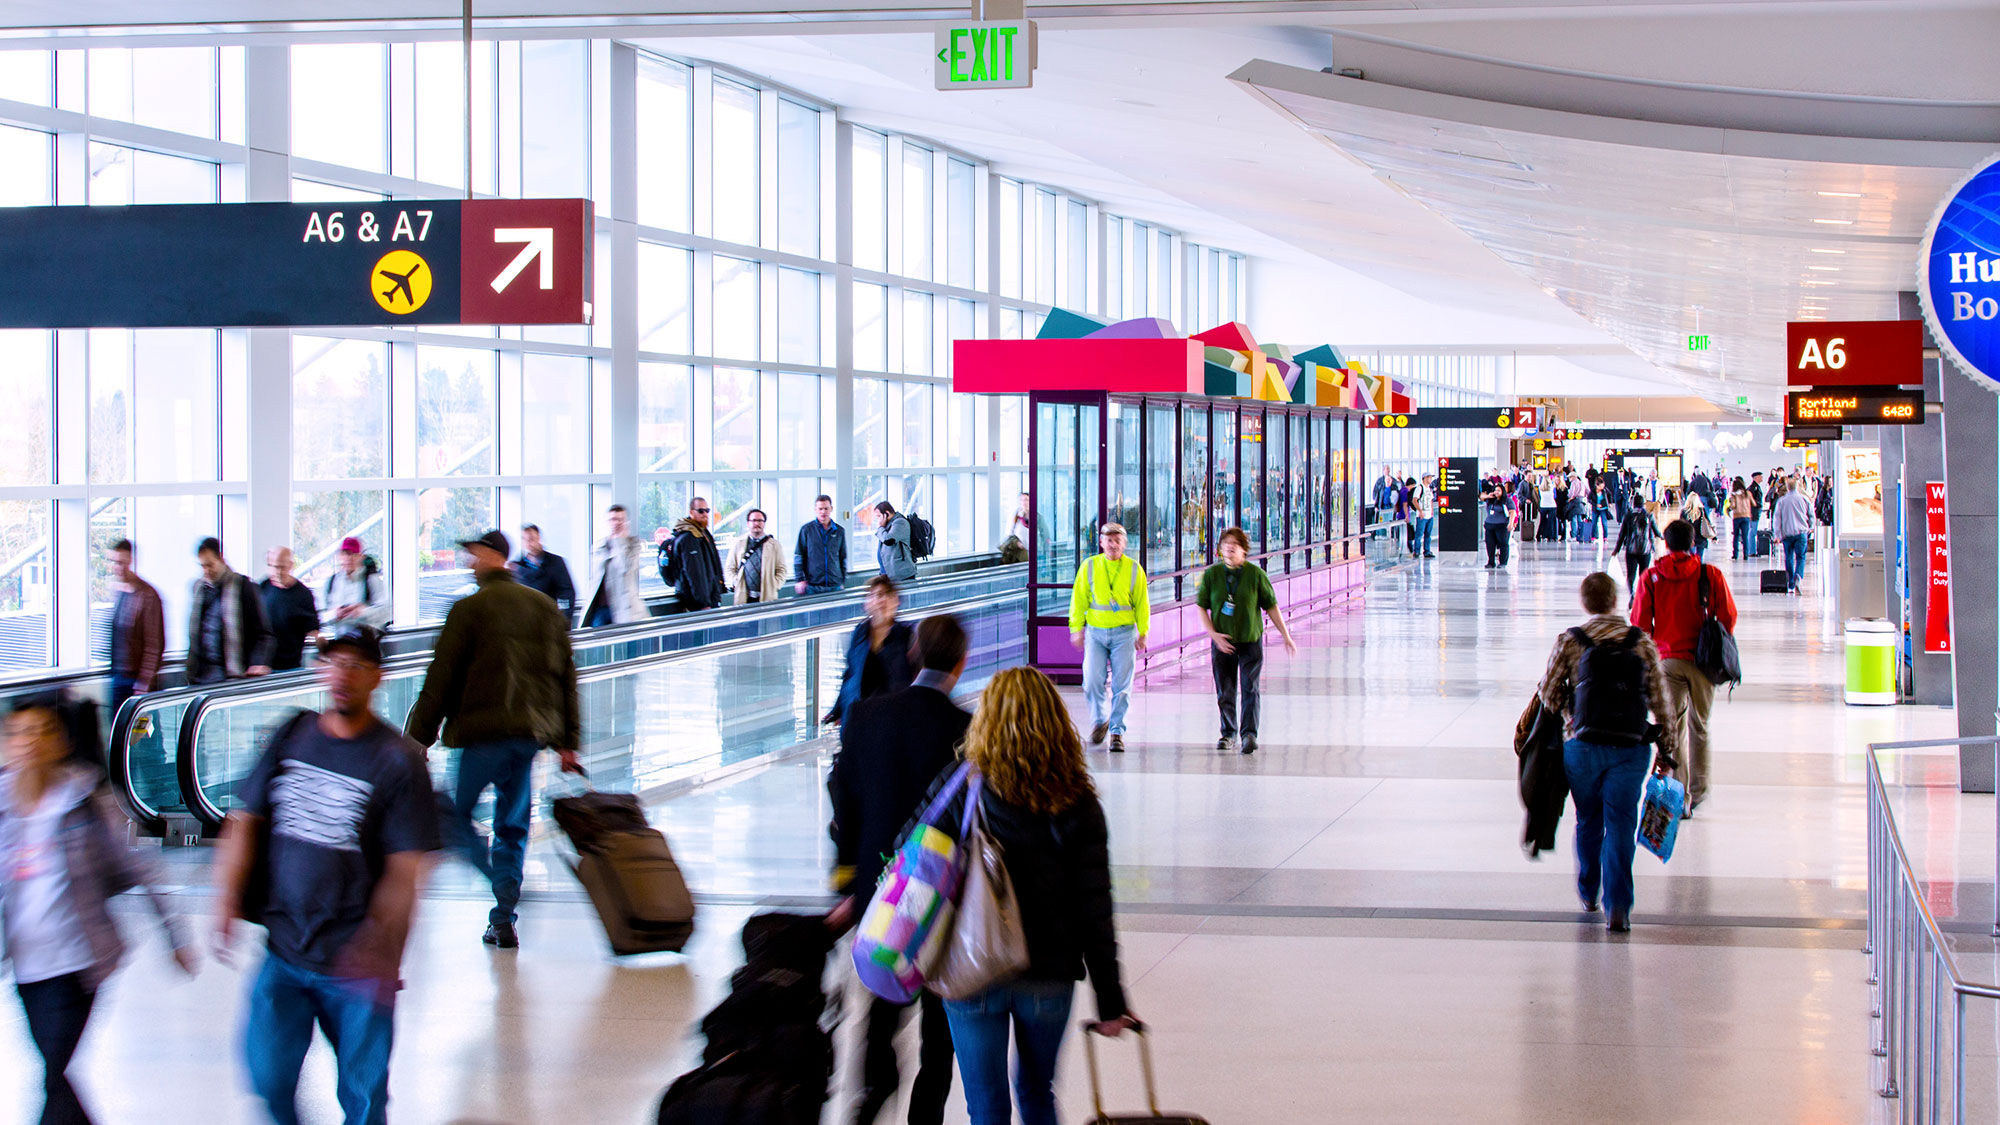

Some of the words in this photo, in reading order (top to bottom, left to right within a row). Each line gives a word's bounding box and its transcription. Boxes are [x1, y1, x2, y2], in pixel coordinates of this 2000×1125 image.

[951, 27, 1018, 82] EXIT
[303, 211, 344, 242] A6
[358, 211, 380, 242] &
[392, 210, 432, 241] A7
[1949, 252, 2000, 283] Hu
[1951, 291, 1999, 321] Bo
[1688, 335, 1709, 351] EXIT
[1798, 337, 1847, 369] A6
[1799, 398, 1857, 409] Portland
[1799, 407, 1843, 418] Asiana
[1882, 405, 1913, 417] 6420
[186, 835, 198, 846] 1A
